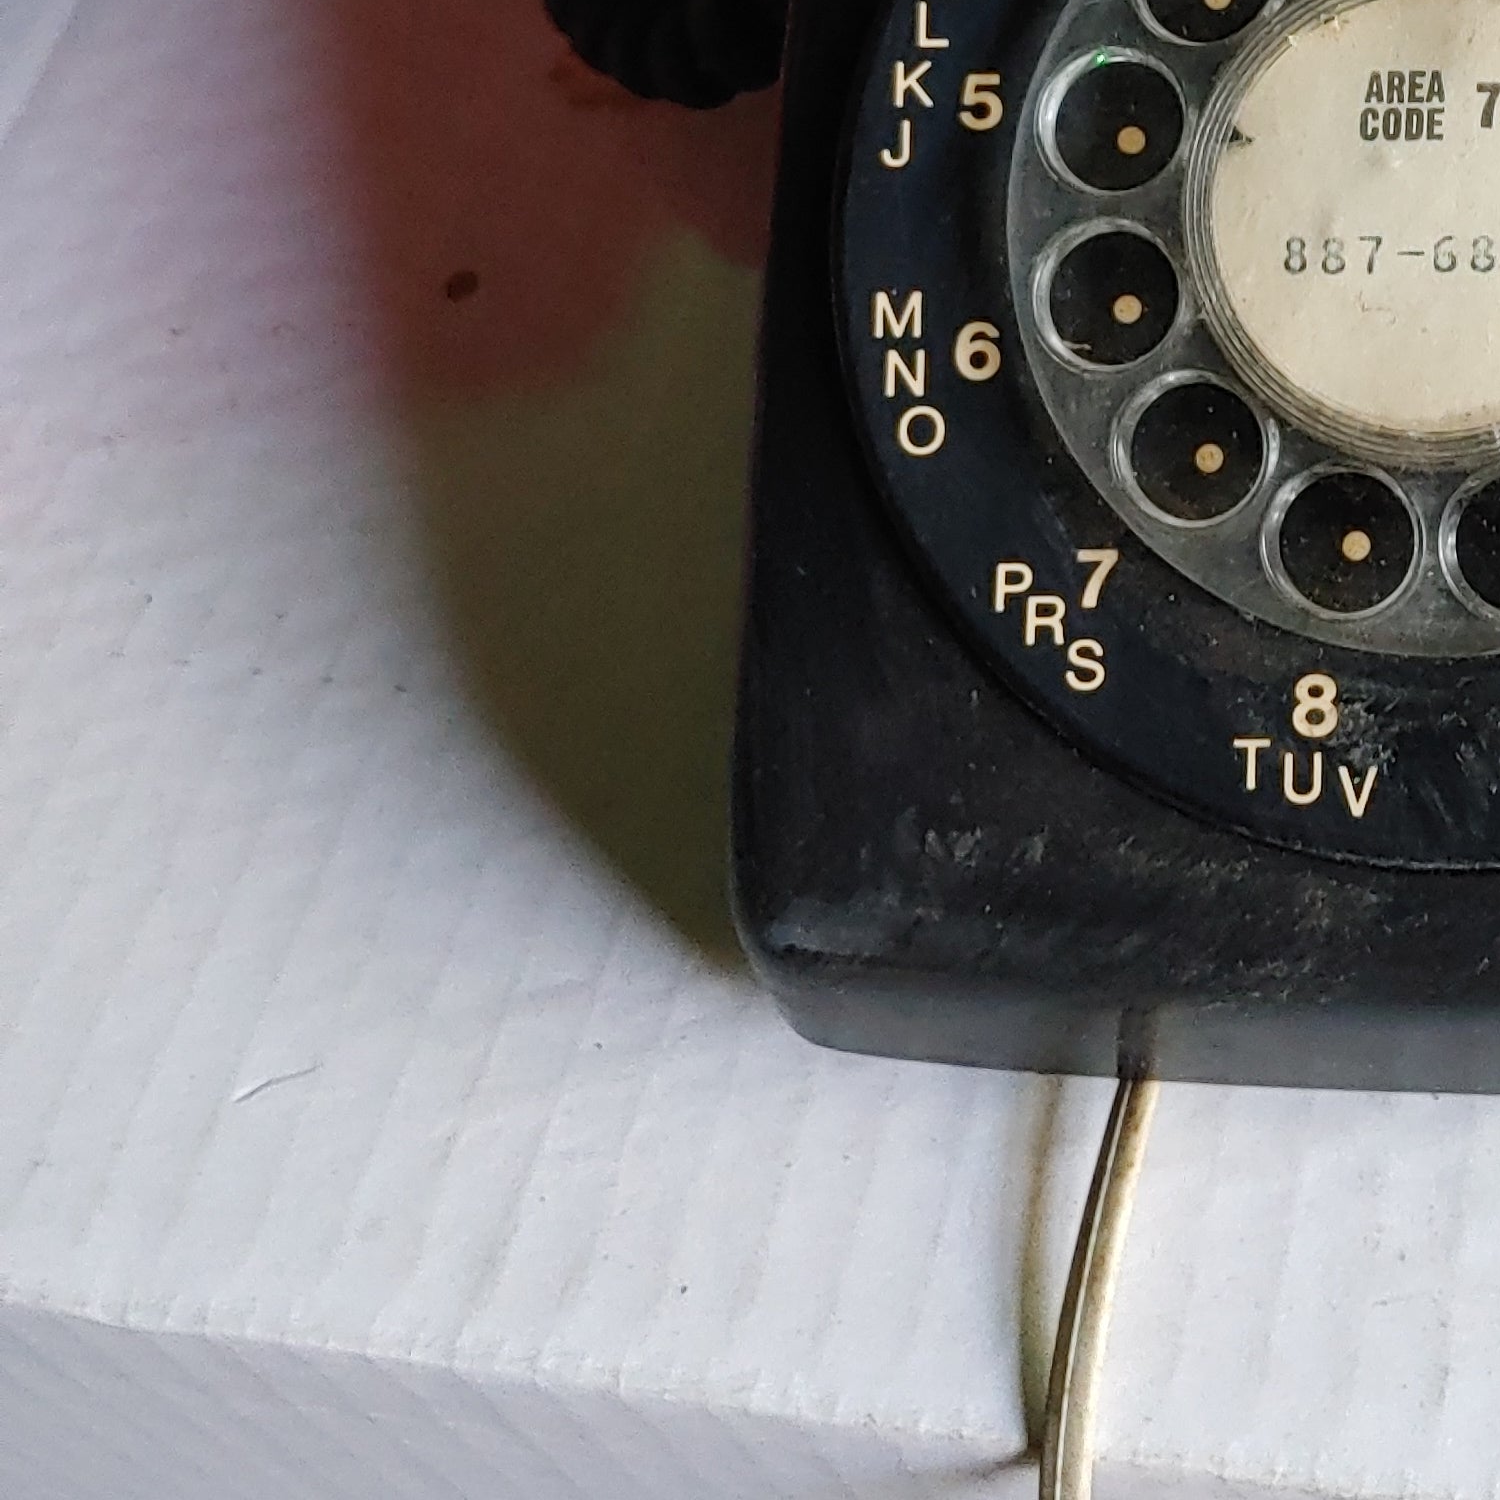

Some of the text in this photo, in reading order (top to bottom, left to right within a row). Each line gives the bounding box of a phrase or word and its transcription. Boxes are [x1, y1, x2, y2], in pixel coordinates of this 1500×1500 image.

[959, 73, 1003, 130] 5
[1364, 70, 1446, 105] AREA
[1359, 107, 1445, 142] CODE
[954, 321, 1001, 381] 6
[1076, 549, 1119, 608] 7
[1292, 673, 1339, 738] 8
[1233, 737, 1379, 818] TUV
